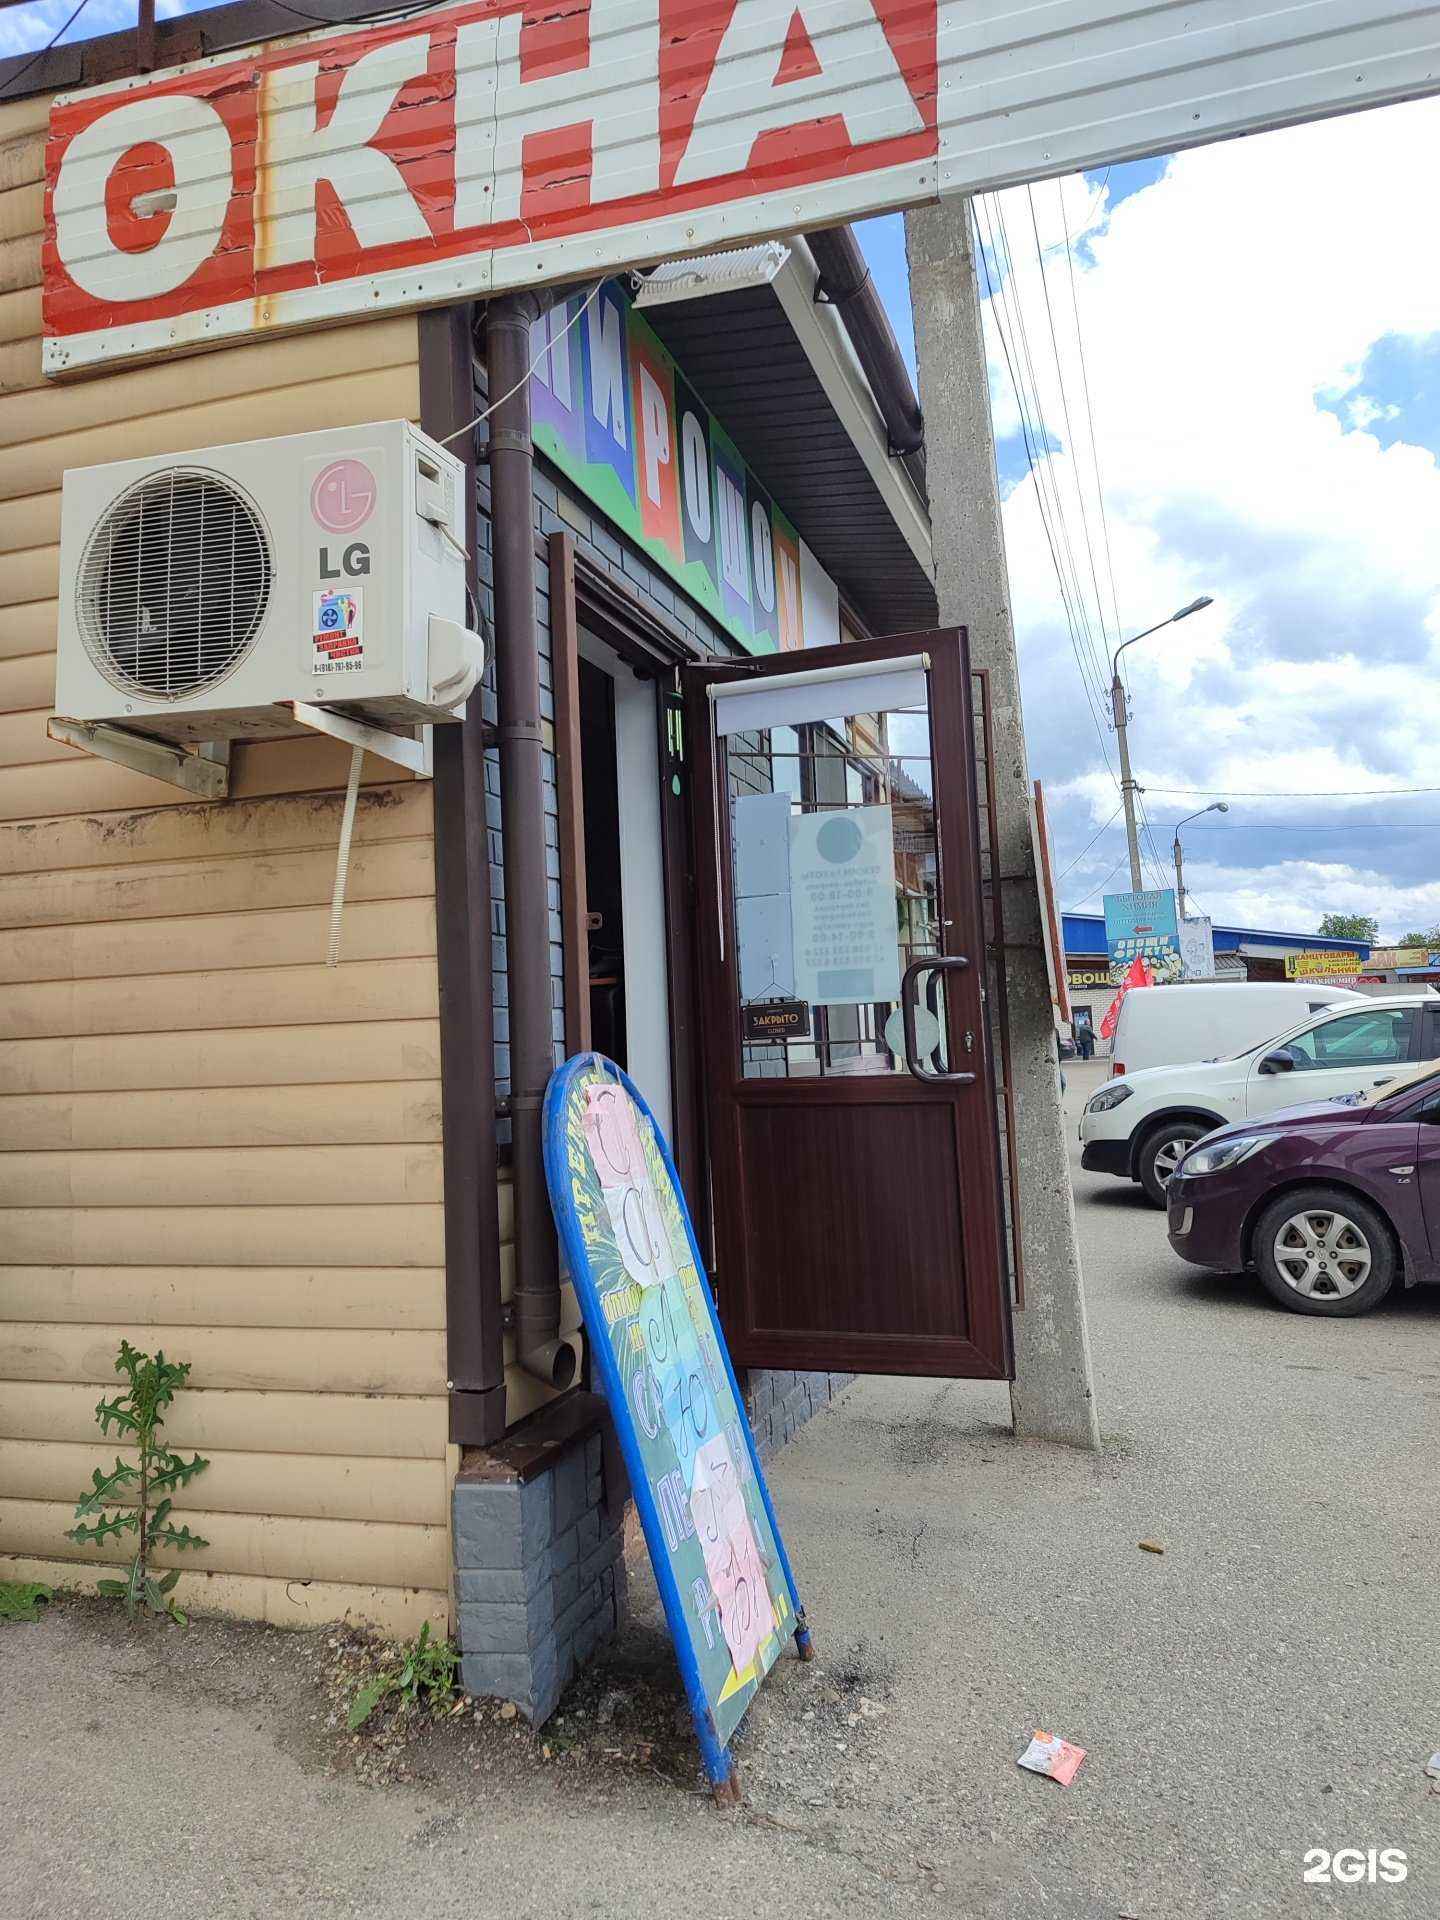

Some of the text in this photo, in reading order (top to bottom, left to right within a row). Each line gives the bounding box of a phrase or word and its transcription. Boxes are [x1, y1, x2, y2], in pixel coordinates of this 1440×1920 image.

[56, 0, 927, 302] ОКНА
[319, 543, 371, 580] LG
[1295, 951, 1356, 961] КАНЦТОВАРЫ
[1300, 966, 1359, 976] ШКОЛЬНИК
[753, 1014, 799, 1026] ЗАКРЫТО
